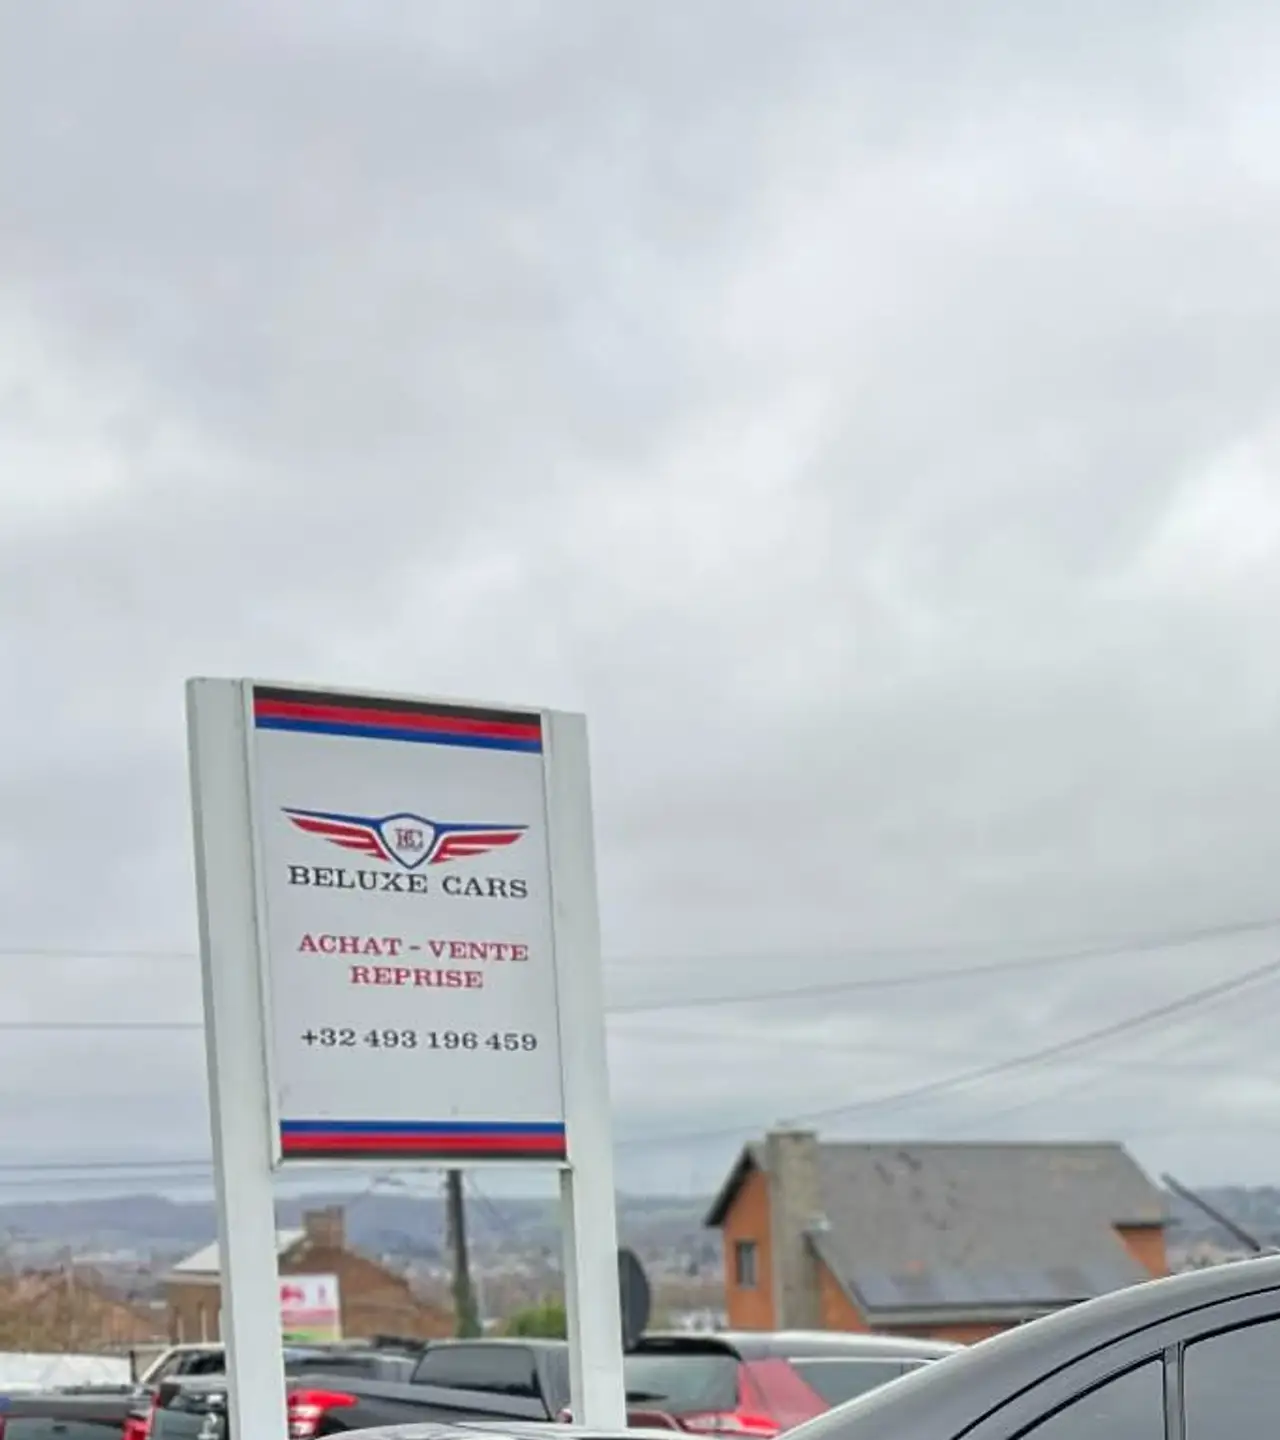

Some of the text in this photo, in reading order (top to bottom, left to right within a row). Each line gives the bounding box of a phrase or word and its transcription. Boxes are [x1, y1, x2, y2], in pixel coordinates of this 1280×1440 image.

[288, 865, 529, 899] BELUXE CARS
[298, 933, 401, 956] ACHAT
[429, 941, 529, 962] VENTE
[351, 965, 484, 989] REPRISE
[301, 1029, 538, 1052] +32 493 196 459
